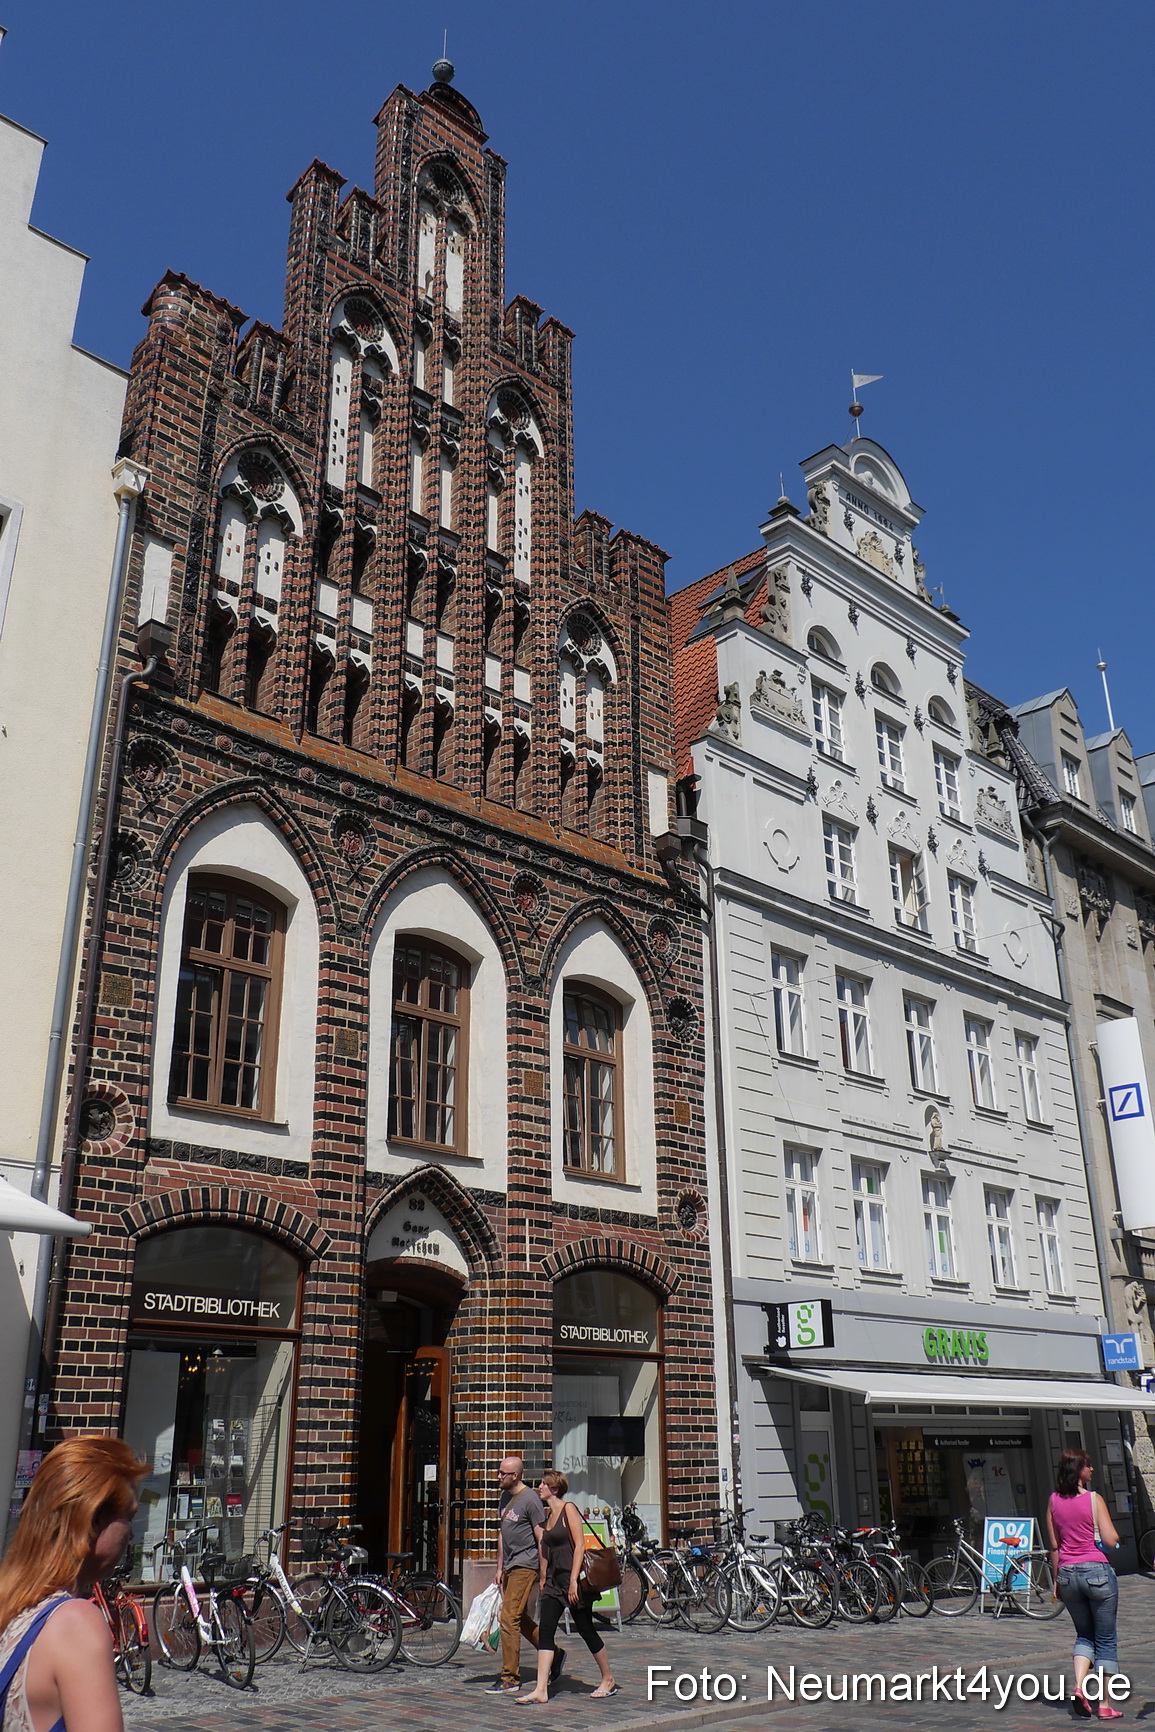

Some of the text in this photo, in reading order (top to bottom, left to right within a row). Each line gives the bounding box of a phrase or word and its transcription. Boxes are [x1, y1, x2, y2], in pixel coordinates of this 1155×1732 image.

[845, 493, 868, 515] ANNO
[144, 1292, 281, 1319] STADTBIBLIOTHEK
[560, 1324, 649, 1344] STADTBIBLIOTHEK
[924, 1327, 989, 1361] GRAVIS
[1108, 1356, 1136, 1365] randstad
[988, 1522, 1029, 1548] 0%
